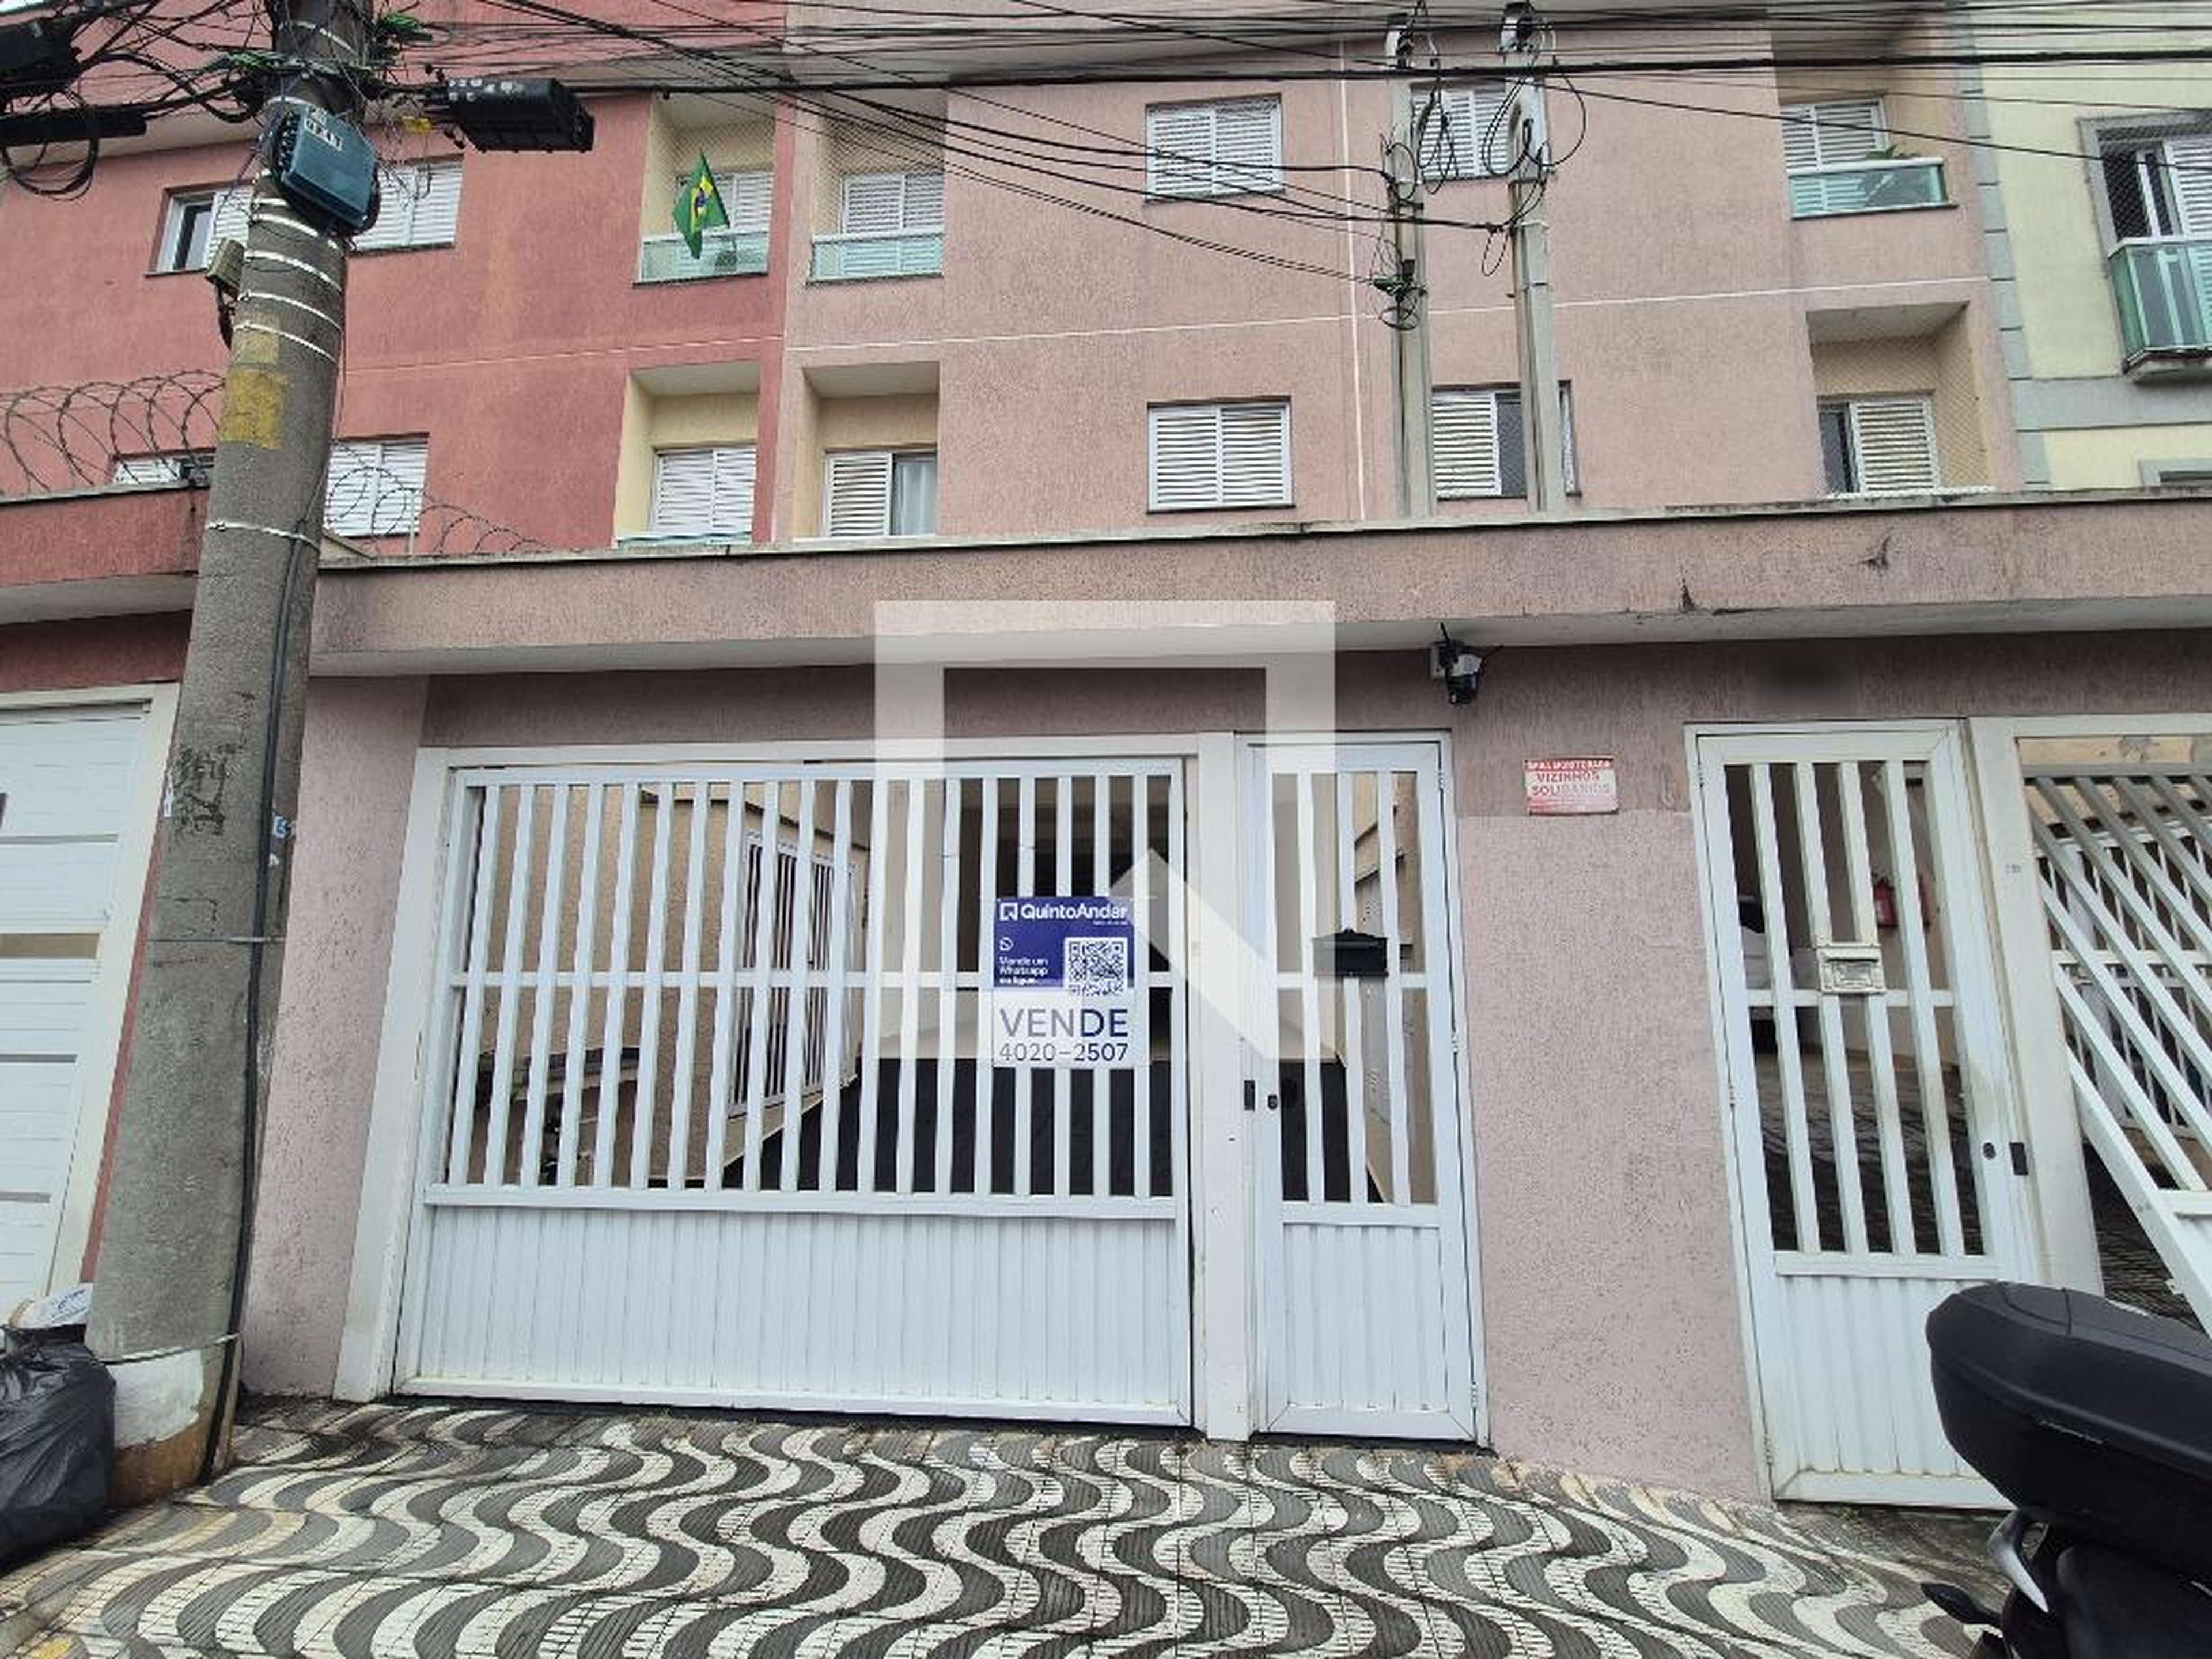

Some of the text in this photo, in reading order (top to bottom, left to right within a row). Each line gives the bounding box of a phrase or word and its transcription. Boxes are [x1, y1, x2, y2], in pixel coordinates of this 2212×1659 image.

[1020, 903, 1127, 920] QuintoAndar
[999, 1009, 1128, 1037] VENDE
[999, 1043, 1128, 1062] 4020-2507
